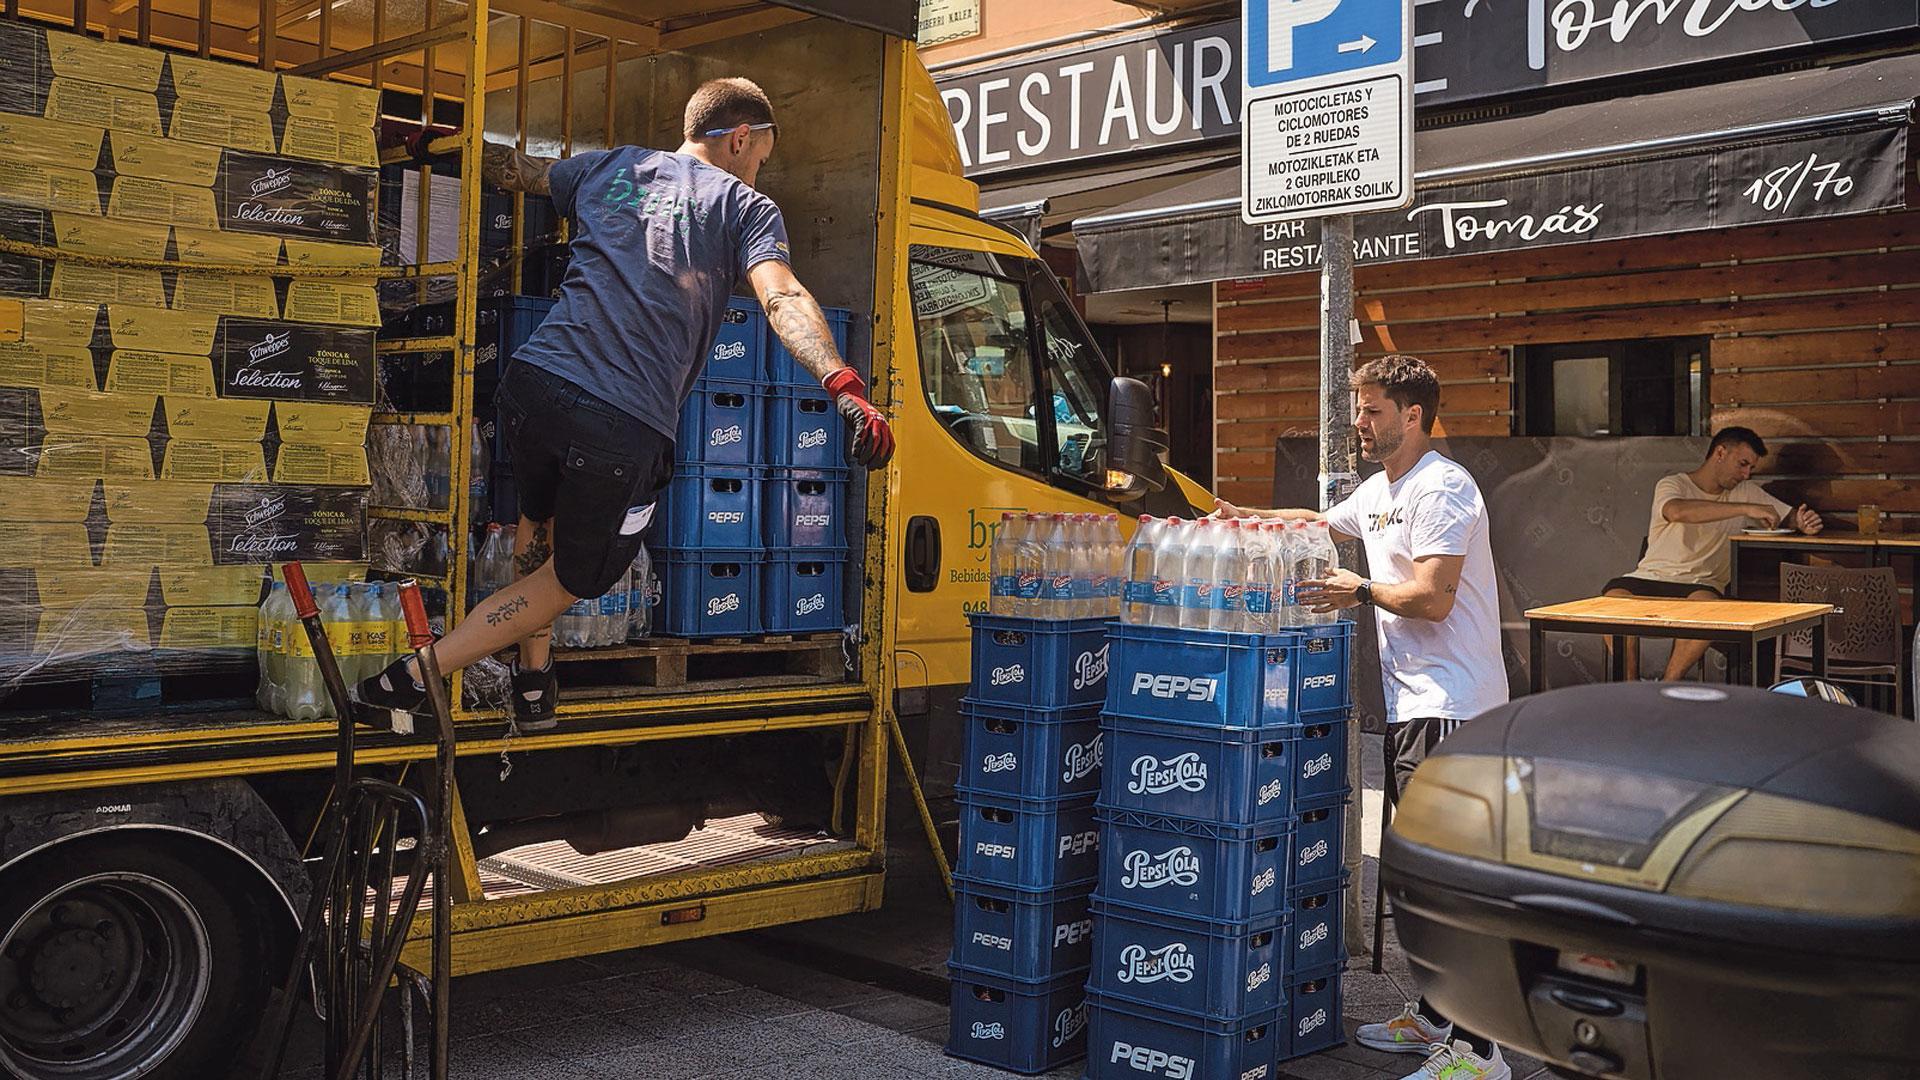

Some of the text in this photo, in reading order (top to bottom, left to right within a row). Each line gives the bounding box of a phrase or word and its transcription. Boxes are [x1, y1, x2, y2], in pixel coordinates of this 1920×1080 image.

[949, 9, 973, 23] KALEA
[1274, 87, 1374, 117] MOTOCICLETAS Y
[1278, 106, 1369, 133] CICLOMOTORES
[1286, 125, 1360, 149] DE 2 RUEDAS
[1268, 147, 1380, 176] MOTOZIKLETAK ETA
[250, 173, 291, 197] Schweppes
[1285, 167, 1361, 190] 2 GURPILEKO
[1742, 151, 1854, 214] 18/70
[1255, 181, 1394, 212] ZIKLOMOTORRAK SOILIK
[232, 202, 306, 226] Selection
[1408, 198, 1604, 249] Tomás
[1263, 222, 1305, 242] BAR
[1263, 232, 1420, 270] RESTARANTE
[249, 336, 290, 362] Schweppes
[230, 368, 304, 389] Selection
[245, 499, 286, 528] Schweppes
[708, 511, 745, 524] PEPSI
[795, 514, 830, 526] PEPSI
[226, 533, 300, 552] Selection
[950, 568, 991, 583] Bebidas
[367, 631, 386, 640] KAS
[1131, 671, 1219, 702] PEPSI
[1303, 674, 1337, 690] PEPSI
[1264, 688, 1289, 701] PEPSI
[976, 842, 1016, 859] PEPSI
[1058, 831, 1100, 859] PEP
[972, 931, 1012, 951] PEPSI
[1055, 919, 1092, 948] PEP
[1110, 1041, 1196, 1080] PEPSI
[1240, 1064, 1269, 1080] PEPSI
